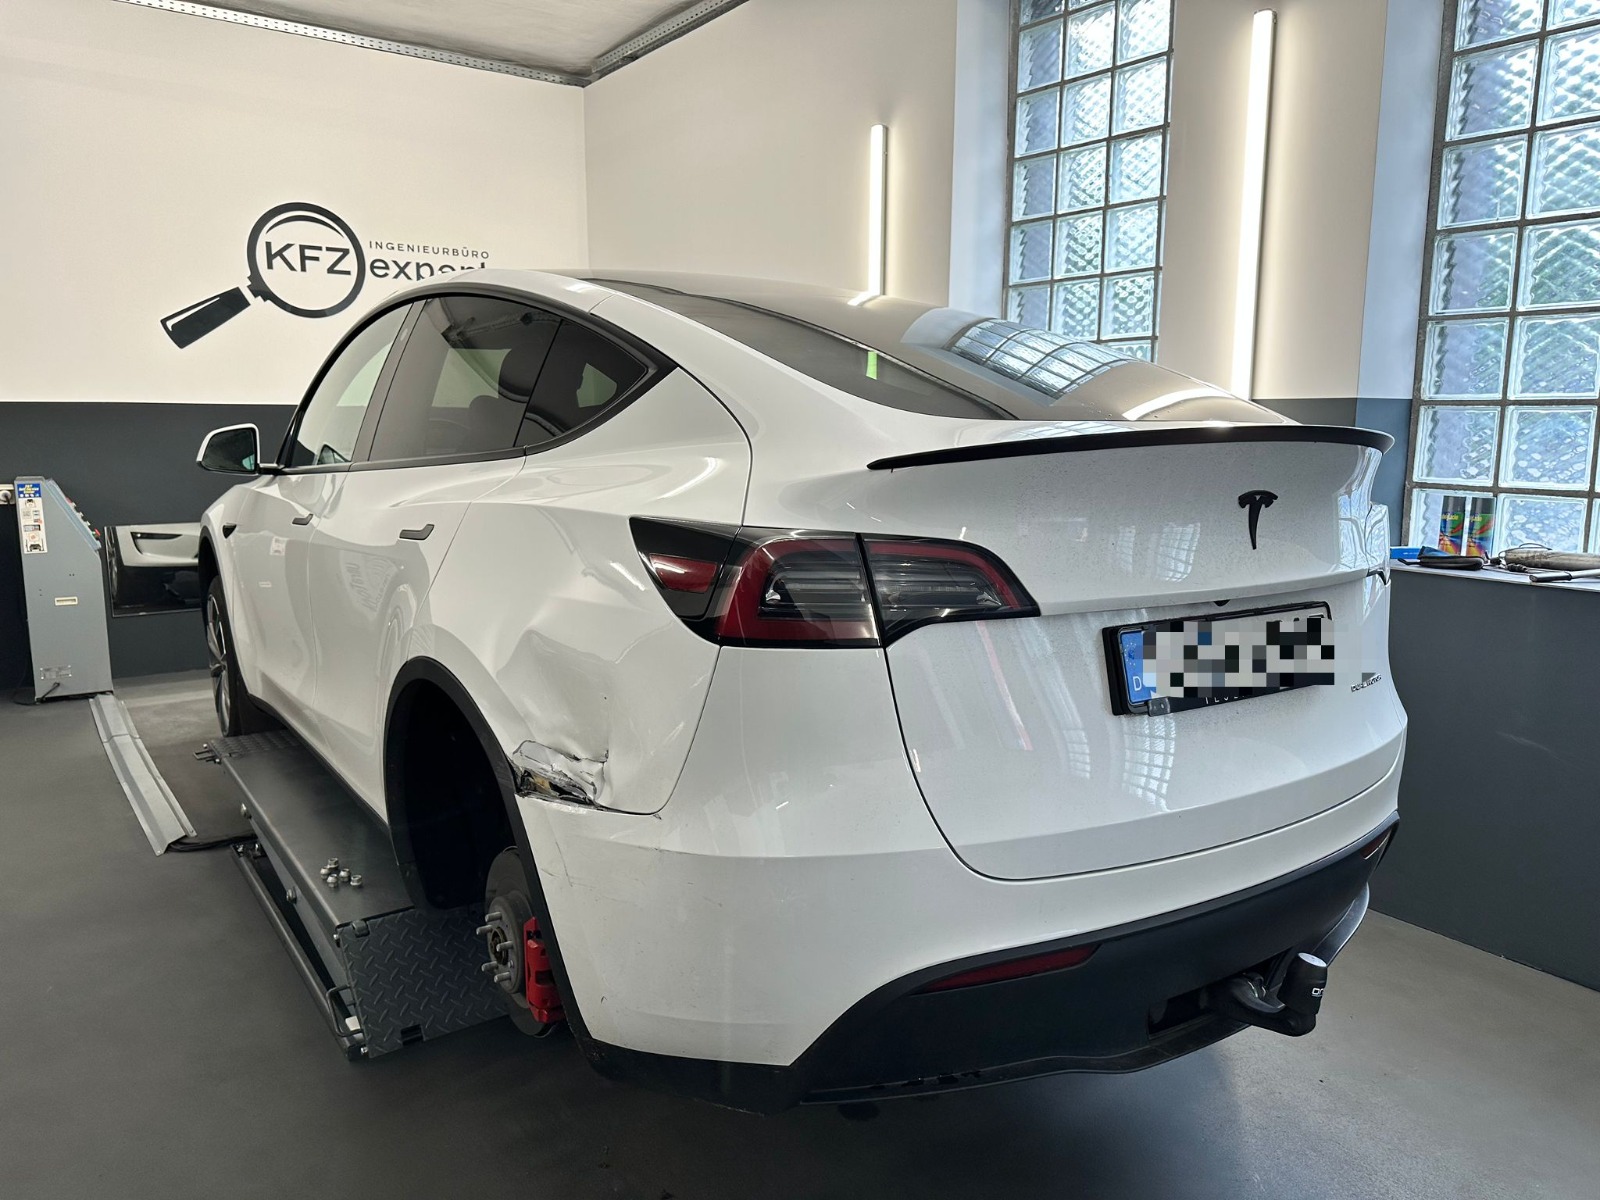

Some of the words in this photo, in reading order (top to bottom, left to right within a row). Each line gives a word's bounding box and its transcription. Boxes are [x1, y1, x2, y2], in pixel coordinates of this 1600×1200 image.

[265, 241, 351, 275] KFZ
[369, 240, 489, 259] INGENIEURBÜRO
[370, 258, 485, 281] exp
[1132, 676, 1142, 691] D
